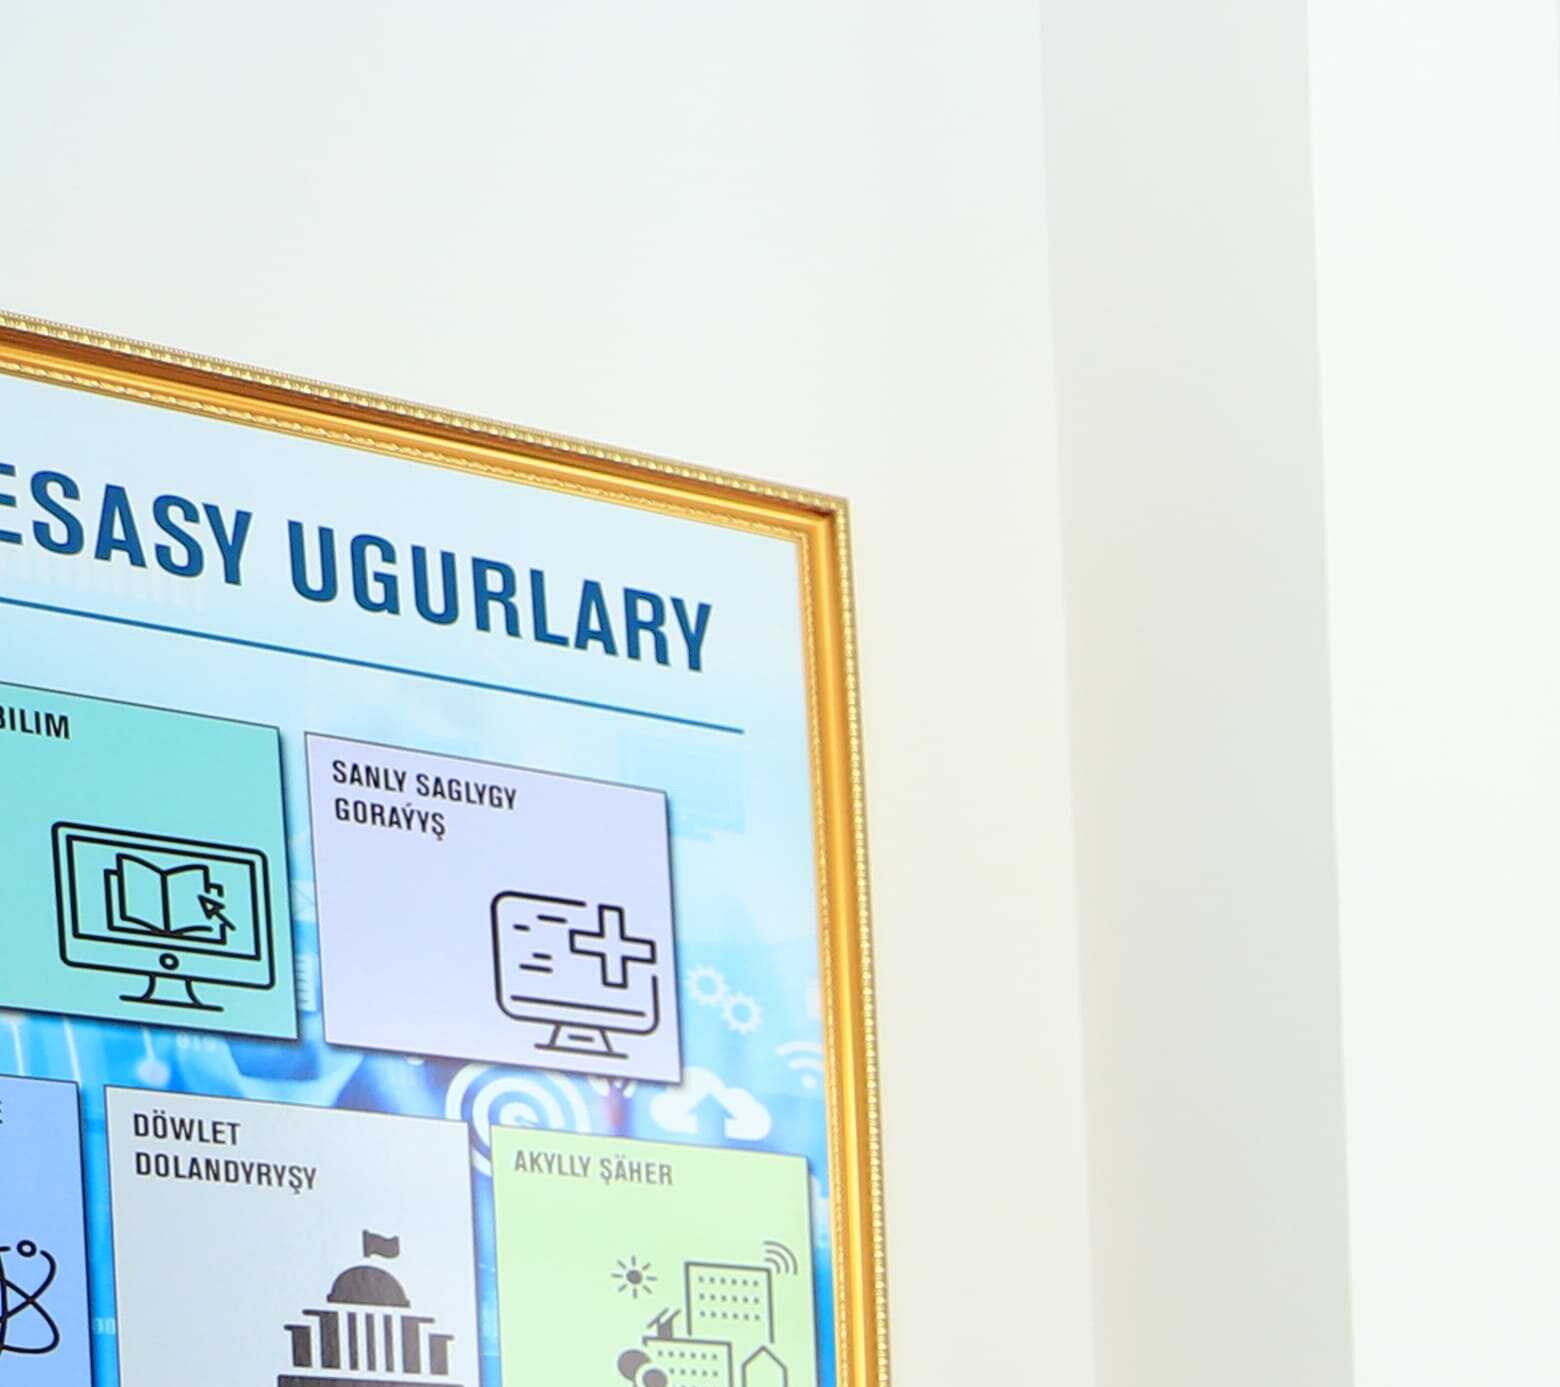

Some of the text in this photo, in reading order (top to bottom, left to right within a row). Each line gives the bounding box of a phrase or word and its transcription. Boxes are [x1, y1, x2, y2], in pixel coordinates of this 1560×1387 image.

[0, 462, 714, 673] ESASY UGURLARY
[332, 759, 517, 810] SANLY SAGLYGY
[335, 797, 446, 841] GORAÝYŞ
[133, 1109, 241, 1146] DÖWLET
[135, 1151, 317, 1194] DOLANDYRYŞY
[514, 1149, 673, 1185] AKYLLY ŞÄHER
